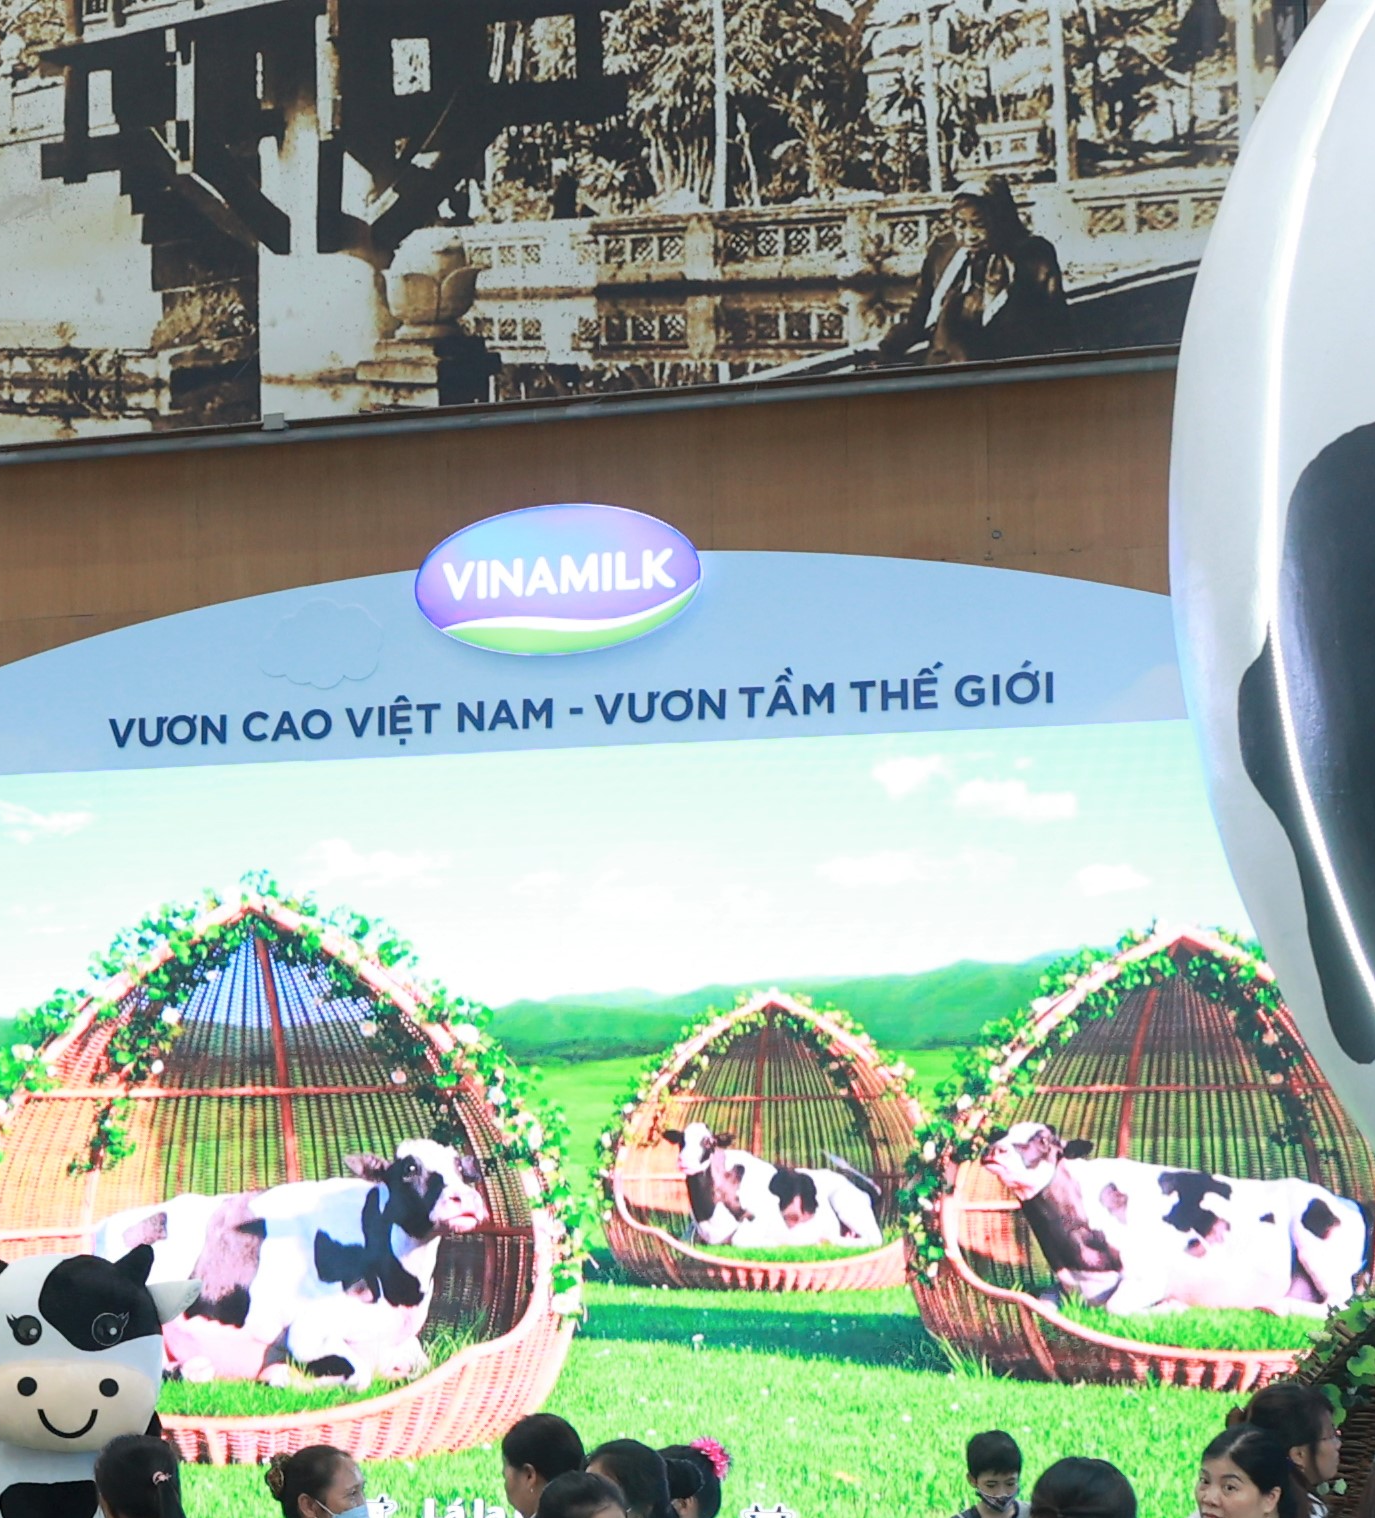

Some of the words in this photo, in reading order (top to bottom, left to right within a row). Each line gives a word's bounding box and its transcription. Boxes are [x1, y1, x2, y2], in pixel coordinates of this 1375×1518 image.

[441, 545, 678, 602] VINAMILK
[109, 715, 227, 749] VƯƠN
[242, 709, 333, 742] CAO
[345, 695, 441, 745] VIỆT
[457, 697, 554, 733] NAM
[594, 688, 727, 725] VƯƠN
[738, 667, 835, 718] TẦM
[849, 661, 943, 713] THẾ
[954, 660, 1054, 708] GIỚI
